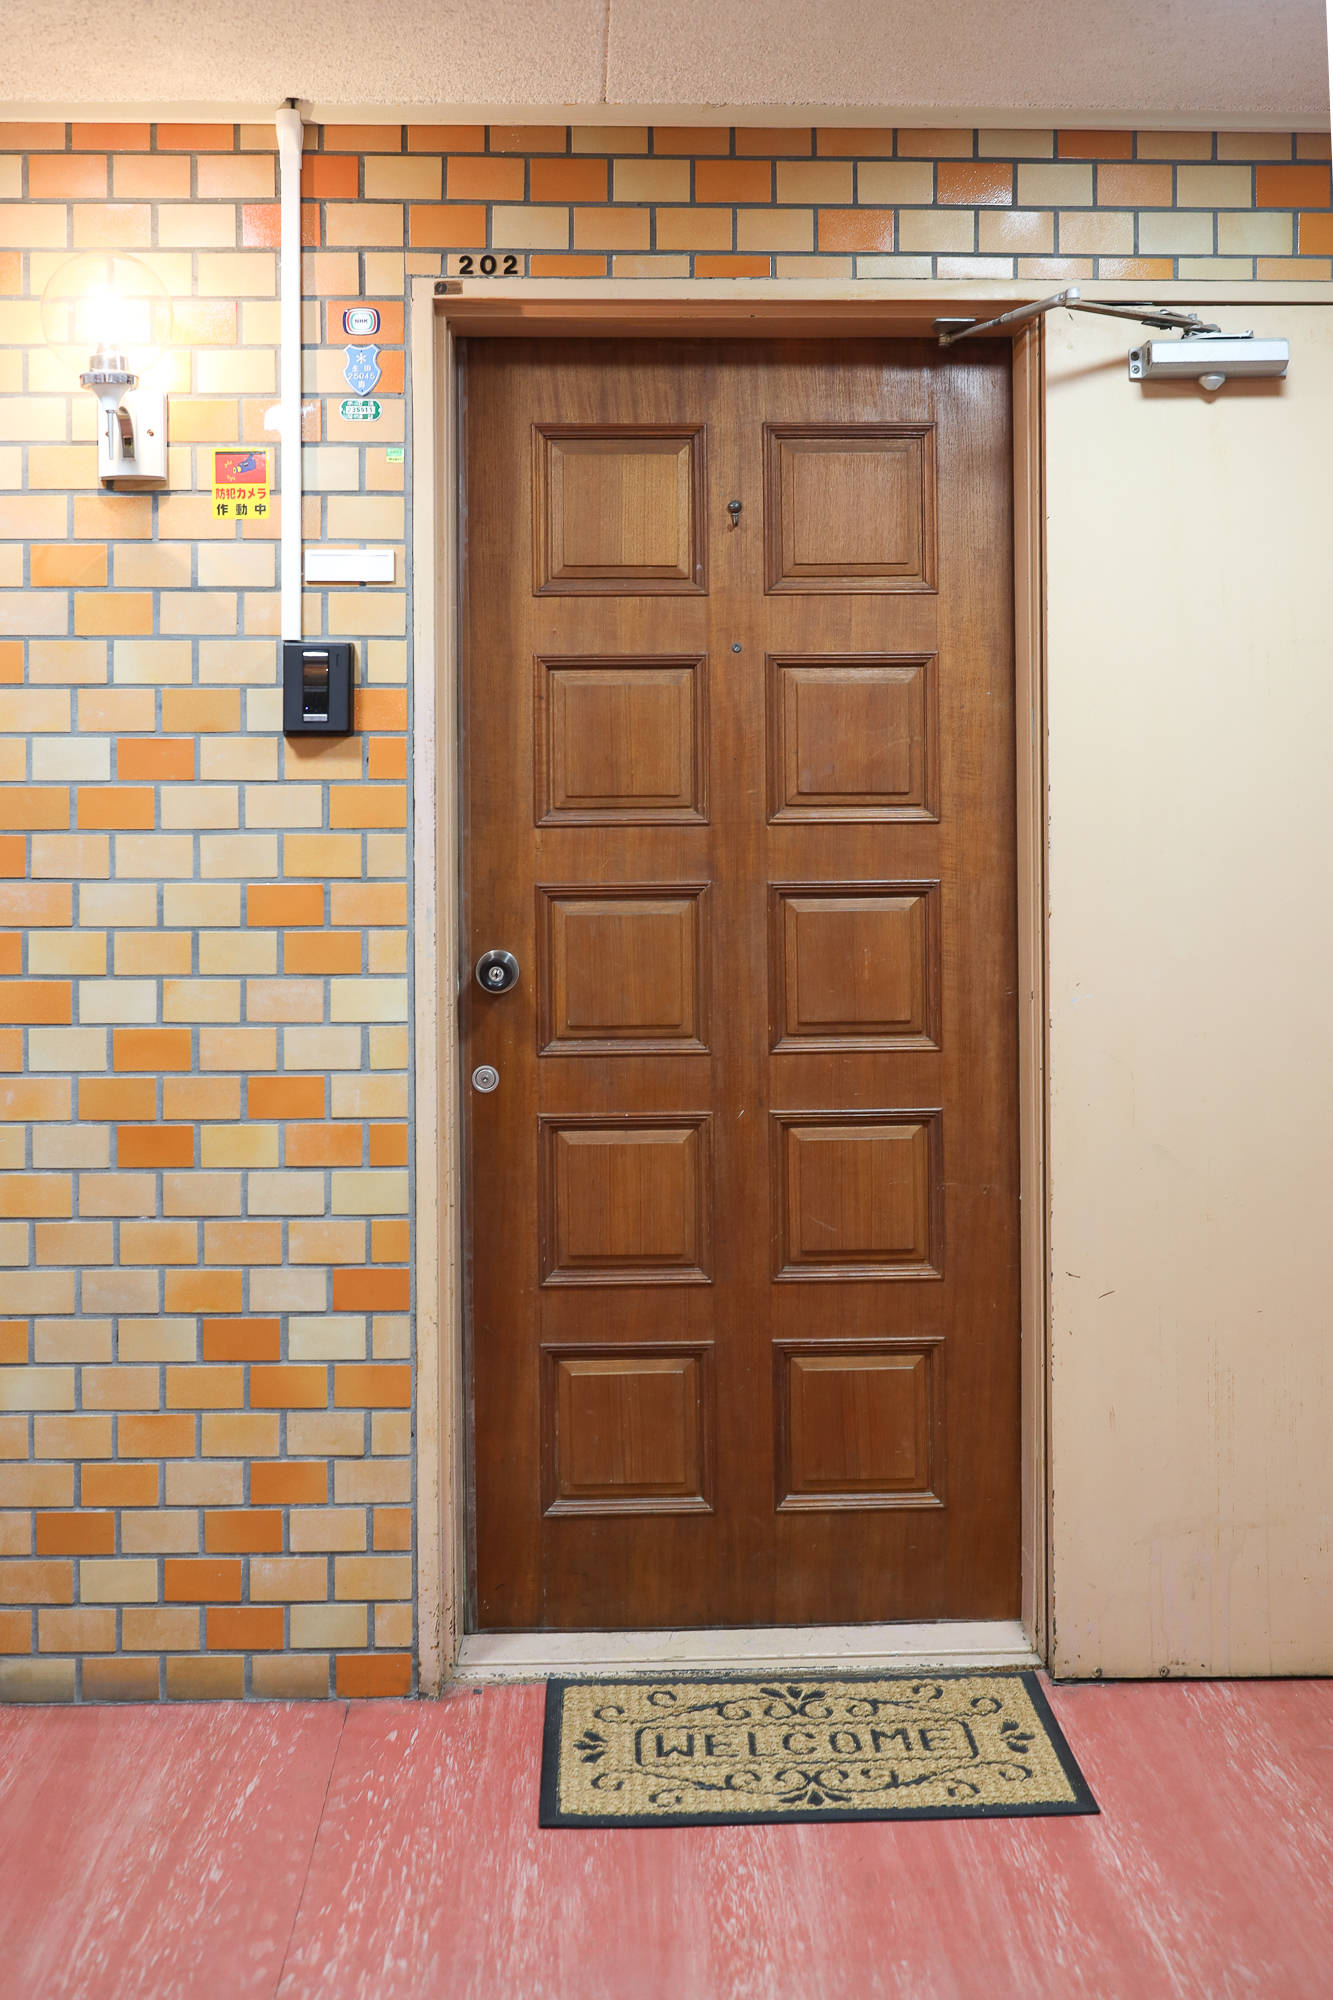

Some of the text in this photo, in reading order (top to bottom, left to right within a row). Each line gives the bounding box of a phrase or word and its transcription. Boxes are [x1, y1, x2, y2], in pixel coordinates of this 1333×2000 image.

[459, 255, 518, 275] 202
[215, 487, 266, 500] 防犯カメラ
[216, 503, 267, 516] 作動中
[655, 1728, 957, 1758] WELCOME
